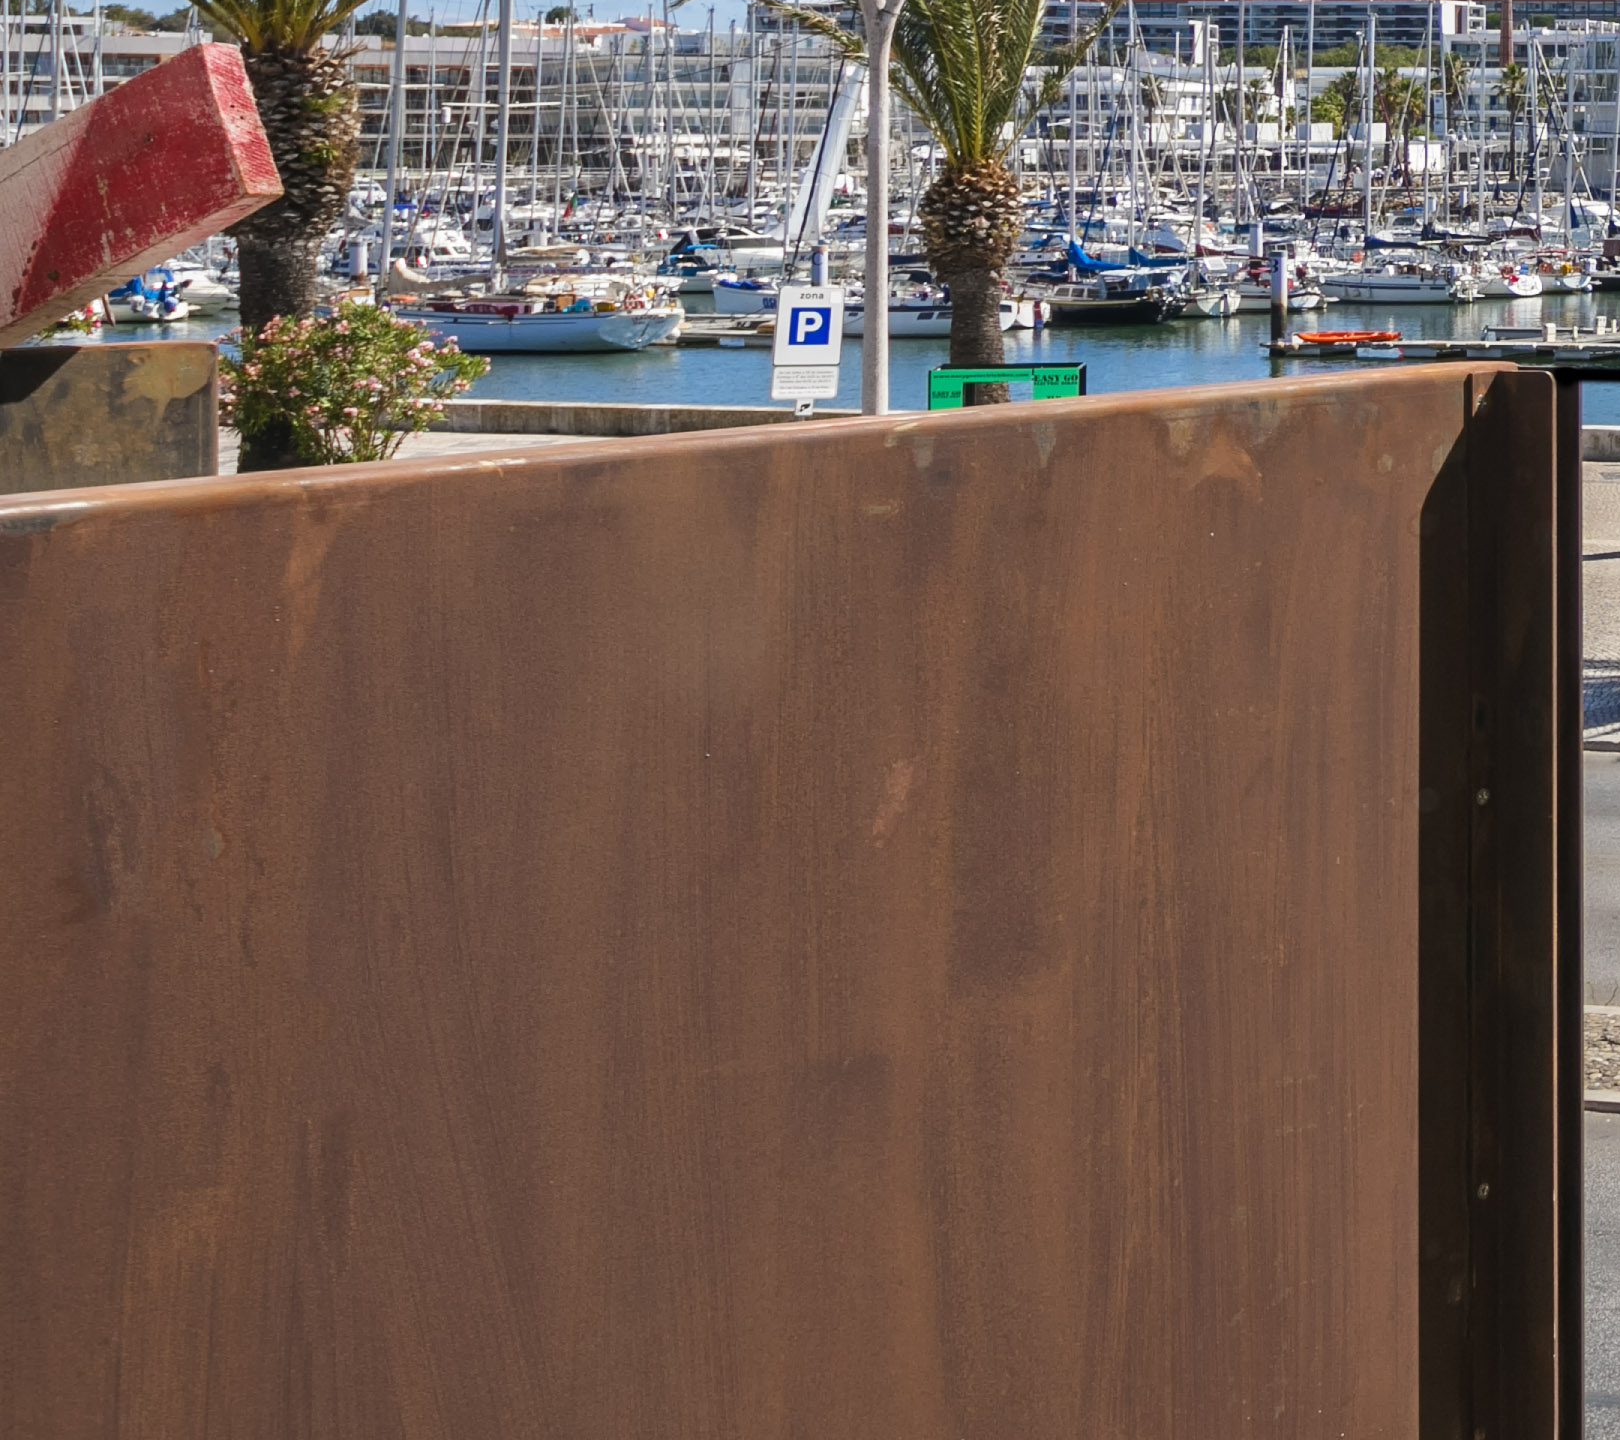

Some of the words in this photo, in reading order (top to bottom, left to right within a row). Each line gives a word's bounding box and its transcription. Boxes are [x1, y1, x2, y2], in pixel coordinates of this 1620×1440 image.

[800, 292, 824, 300] zona
[796, 311, 823, 343] P
[1034, 374, 1061, 382] EASY
[1064, 374, 1079, 382] GO
